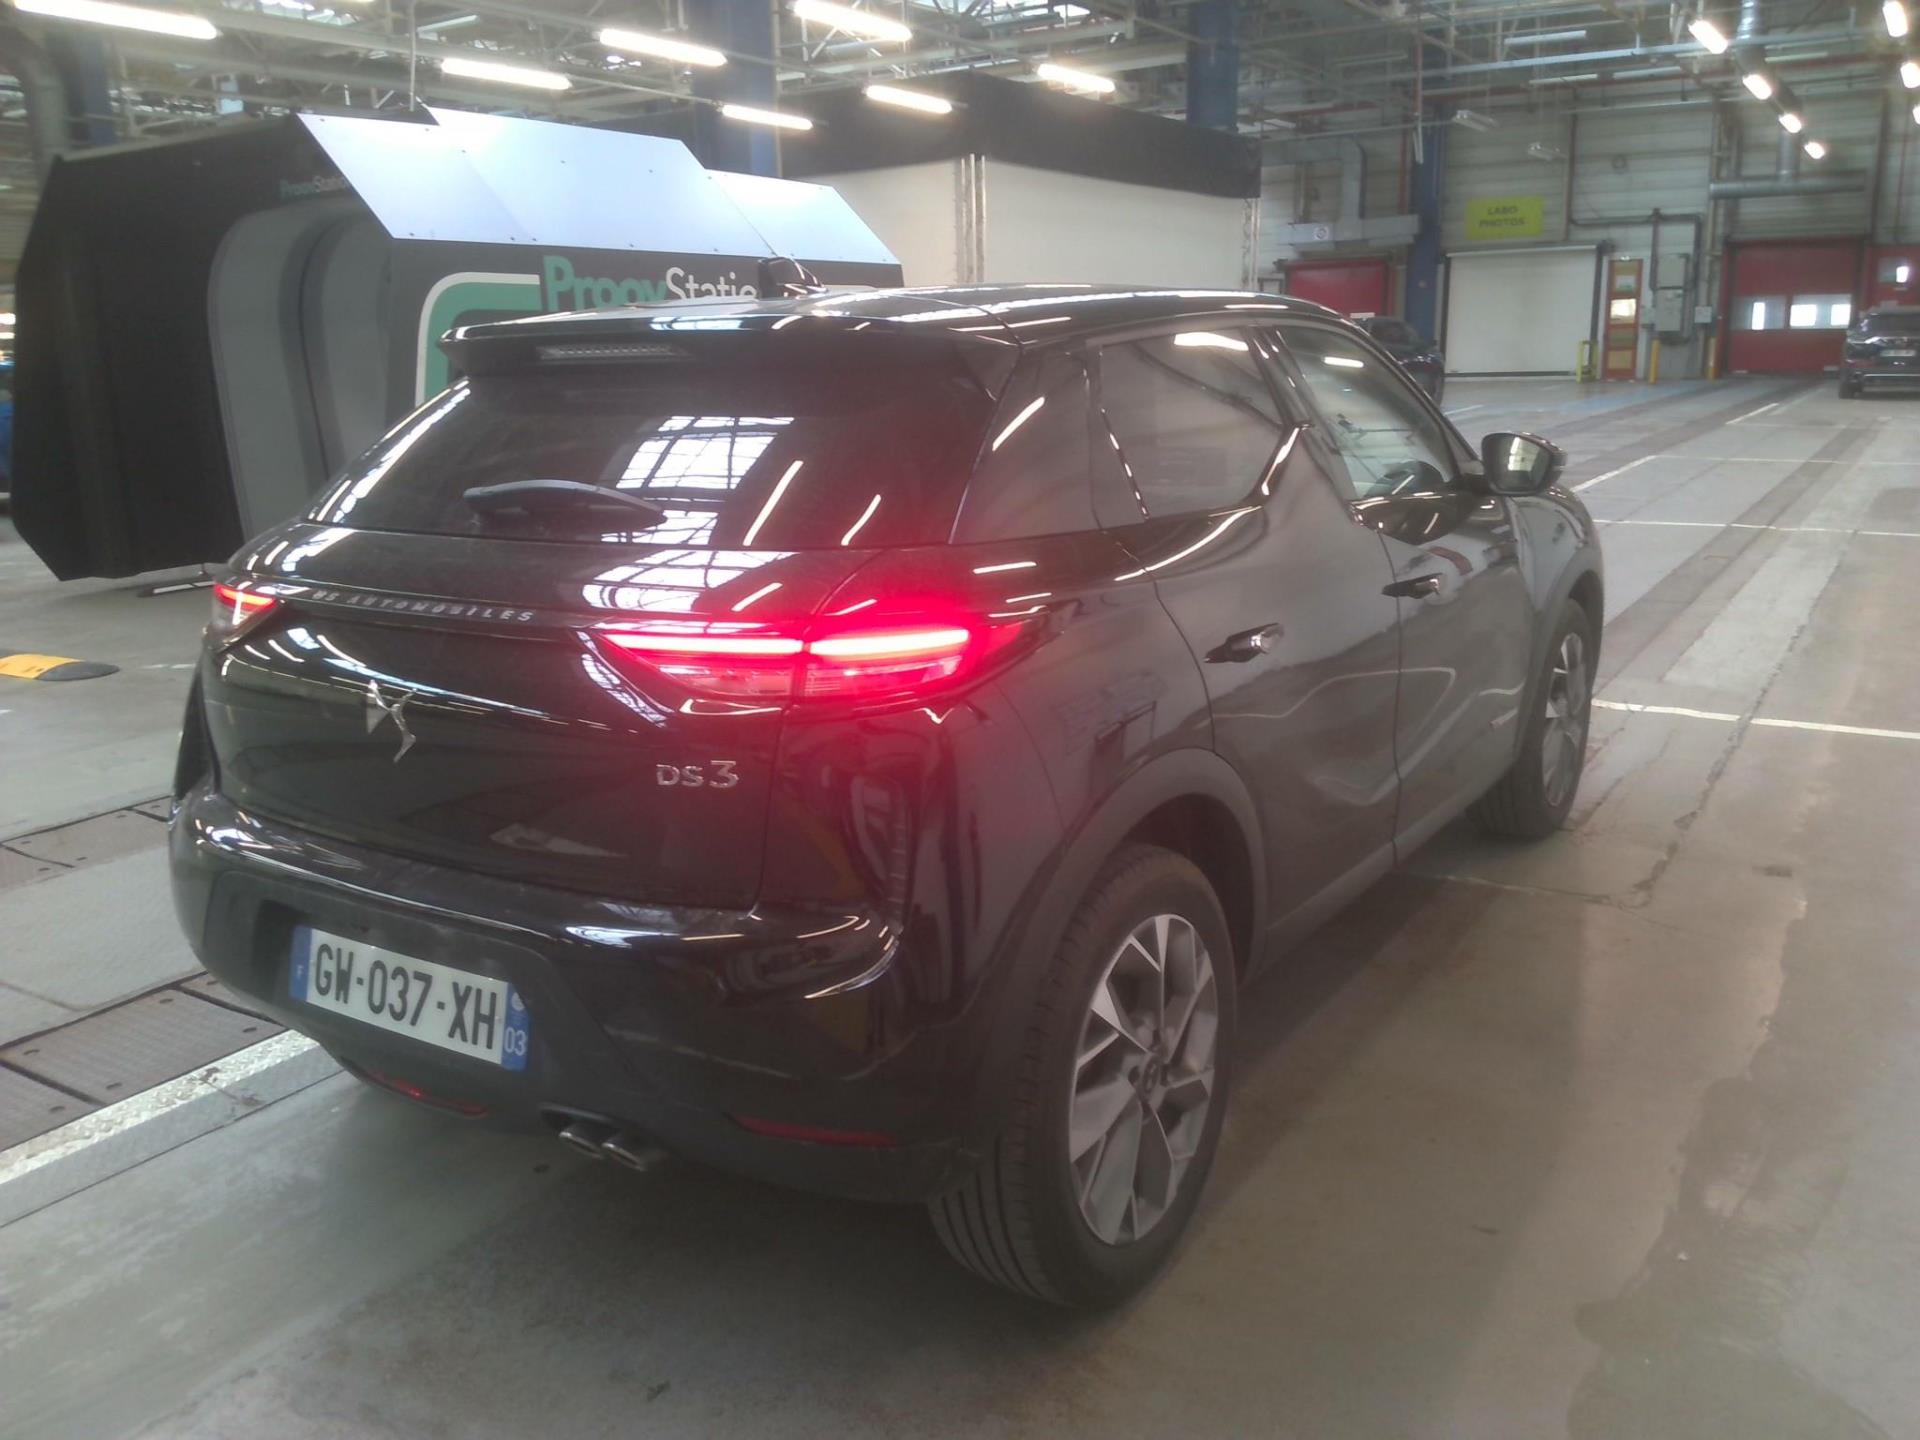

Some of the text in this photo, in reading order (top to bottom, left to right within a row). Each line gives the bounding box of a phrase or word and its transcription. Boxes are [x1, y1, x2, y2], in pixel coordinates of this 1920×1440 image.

[346, 594, 533, 622] AUTOMOBILES
[656, 760, 739, 788] DS 3
[314, 944, 497, 1049] GW-037-XH
[504, 1026, 527, 1057] 03
